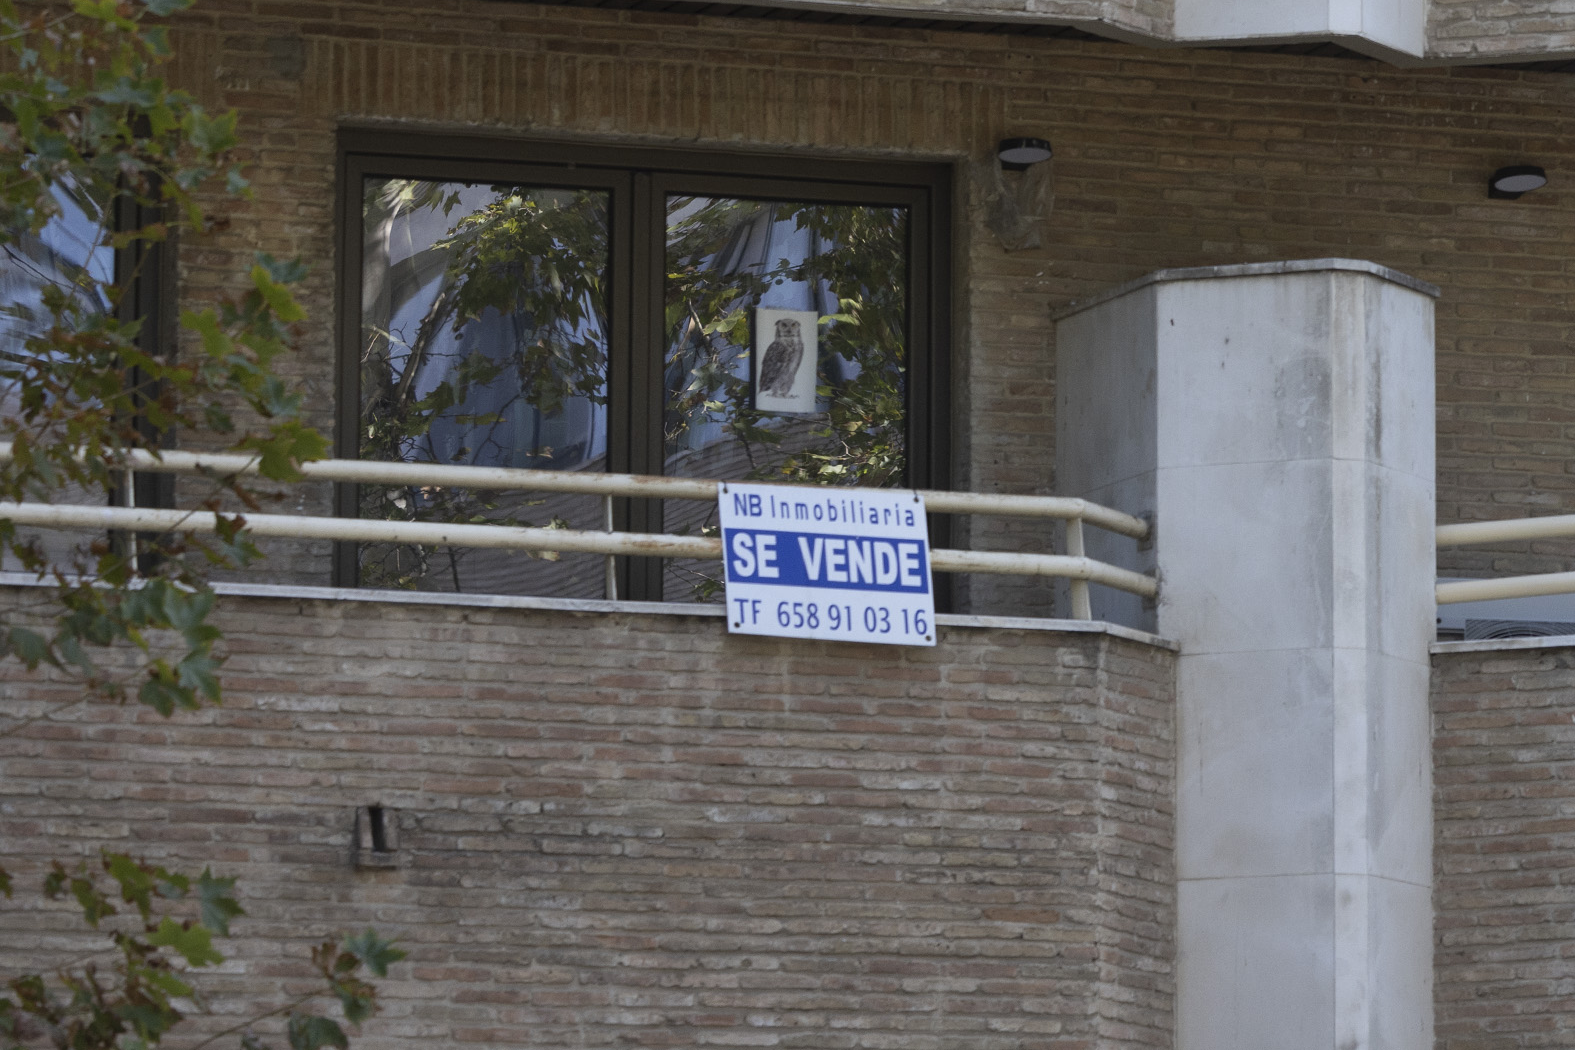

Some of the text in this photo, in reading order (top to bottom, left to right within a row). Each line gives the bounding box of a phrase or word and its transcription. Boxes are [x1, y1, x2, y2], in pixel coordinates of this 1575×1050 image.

[733, 493, 915, 527] NB Inmobiliaria
[732, 532, 922, 587] SE VENDE
[733, 598, 928, 635] TF 658 91 03 16
